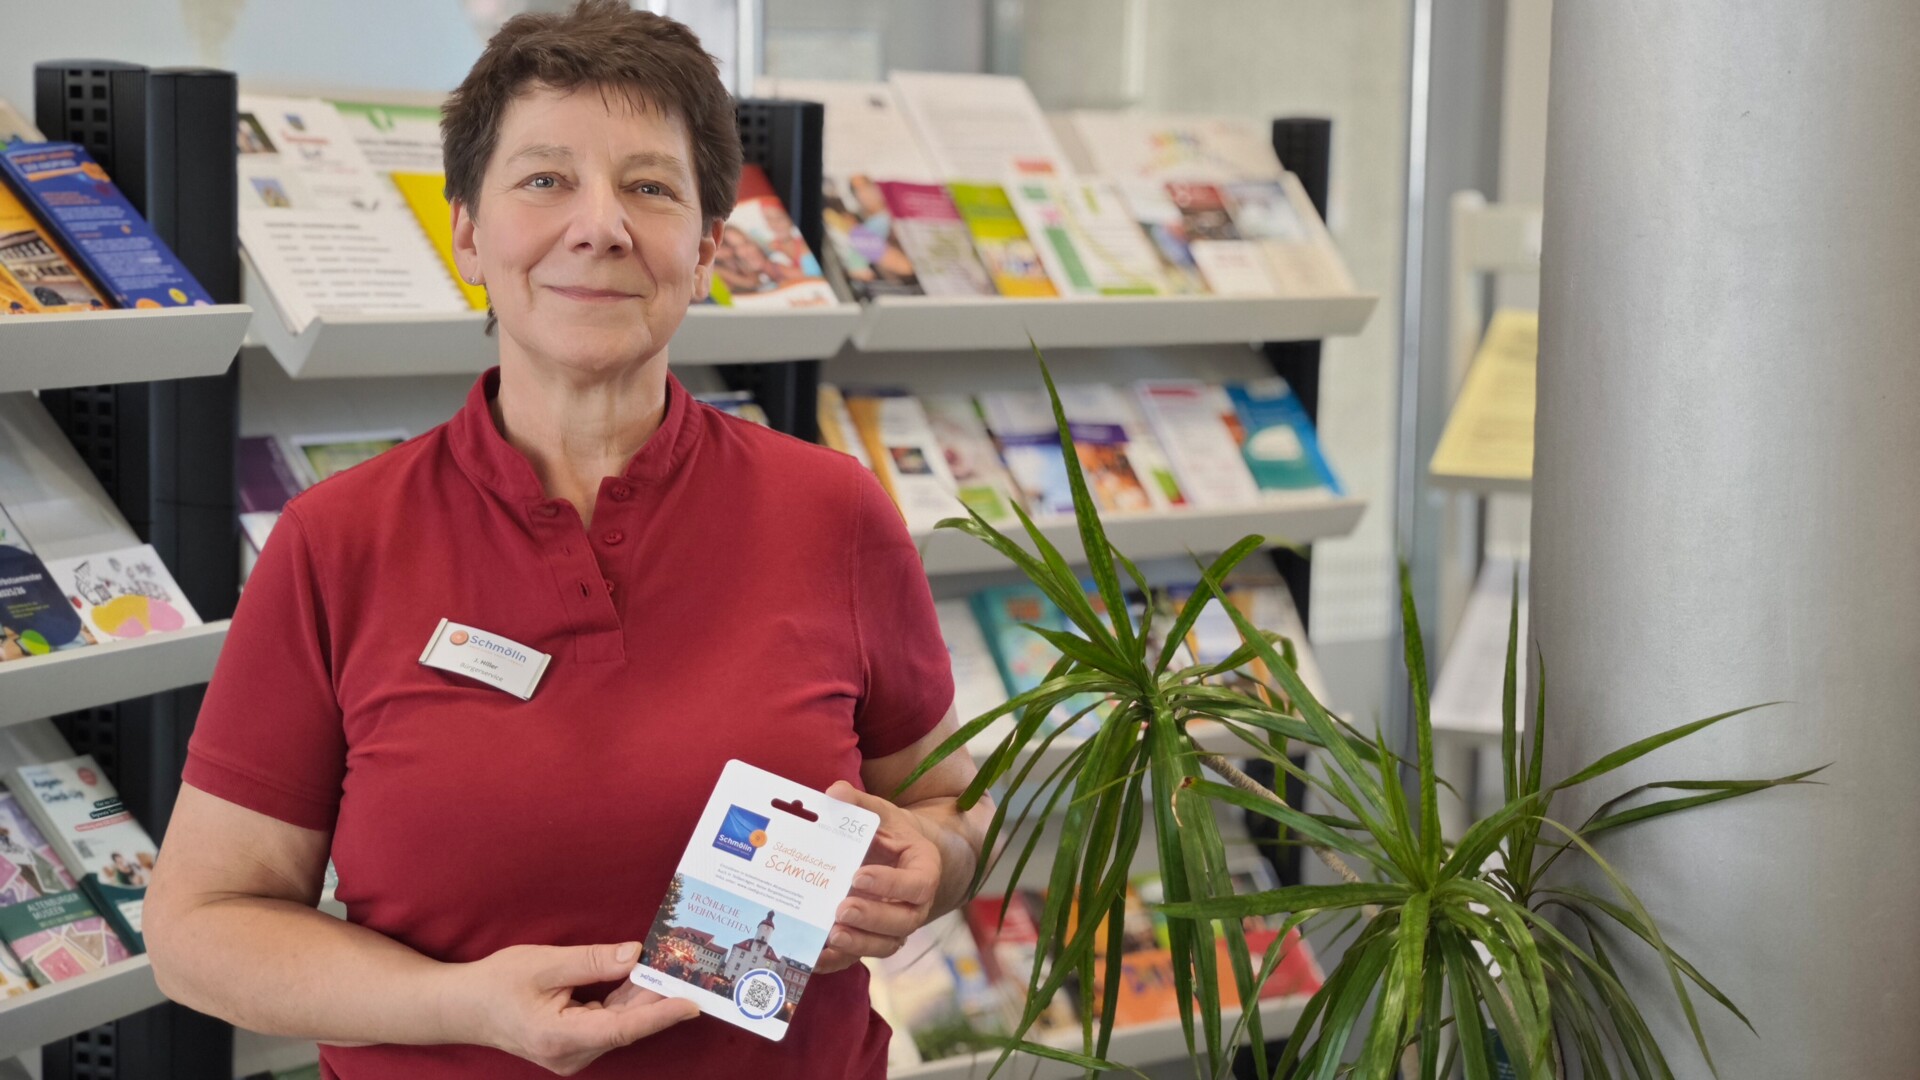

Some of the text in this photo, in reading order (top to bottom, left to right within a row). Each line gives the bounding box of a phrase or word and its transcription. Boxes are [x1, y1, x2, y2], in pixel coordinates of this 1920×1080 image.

[469, 635, 527, 663] Schmölln
[459, 662, 504, 682] Bürgerservice
[839, 816, 869, 837] 25€
[718, 833, 753, 853] Schmölln
[773, 841, 837, 872] Stadtgutschein
[765, 854, 830, 889] Schmölln
[27, 892, 80, 913] ALTENBURGER
[32, 905, 66, 921] MUSEEN
[690, 891, 741, 918] FRÖHLICHE
[687, 903, 752, 935] WEIHNACHTEN
